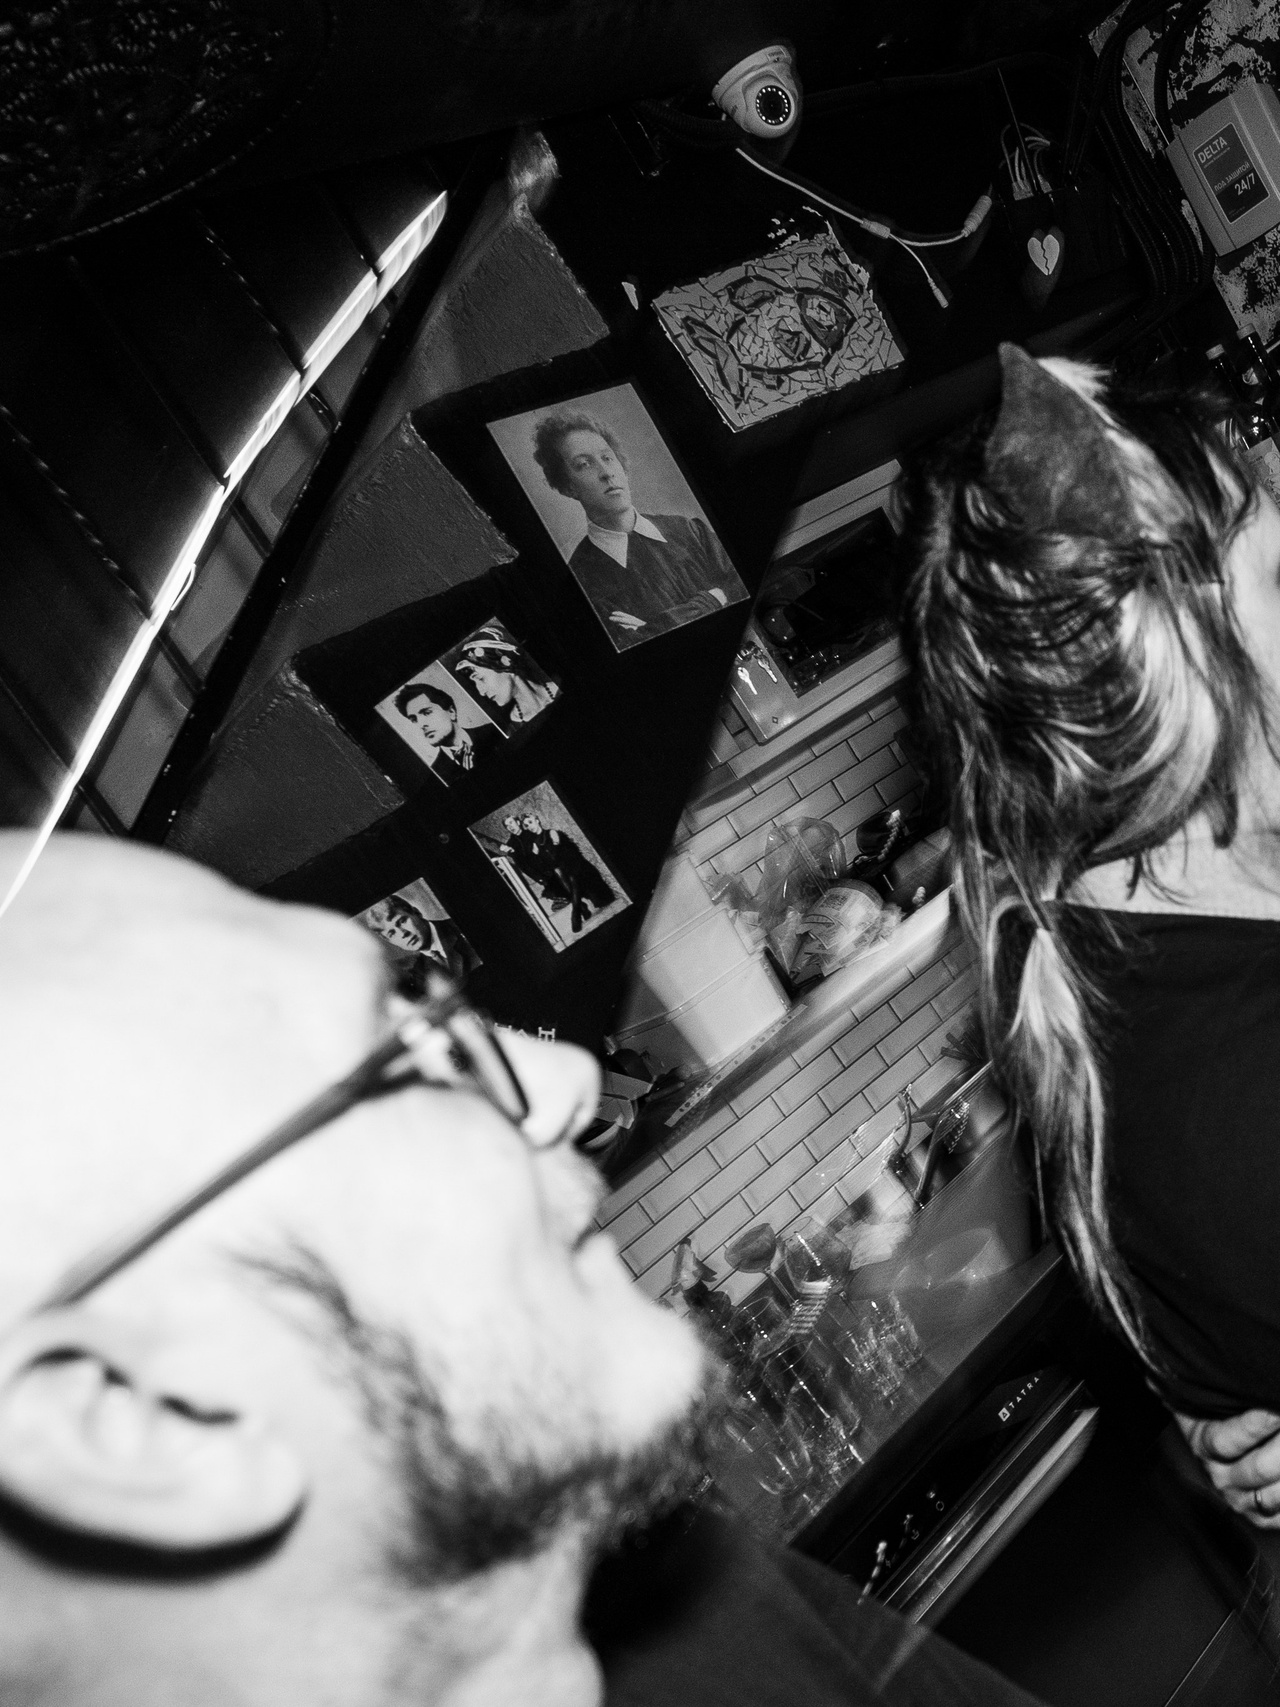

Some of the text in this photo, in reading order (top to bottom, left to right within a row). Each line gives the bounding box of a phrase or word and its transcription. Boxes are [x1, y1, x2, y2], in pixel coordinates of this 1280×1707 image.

[1197, 136, 1228, 164] DELTA
[1214, 161, 1251, 192] ПОД ЗАЩИТОЙ
[1234, 172, 1256, 196] 24/7
[1008, 1376, 1040, 1409] TATRA
